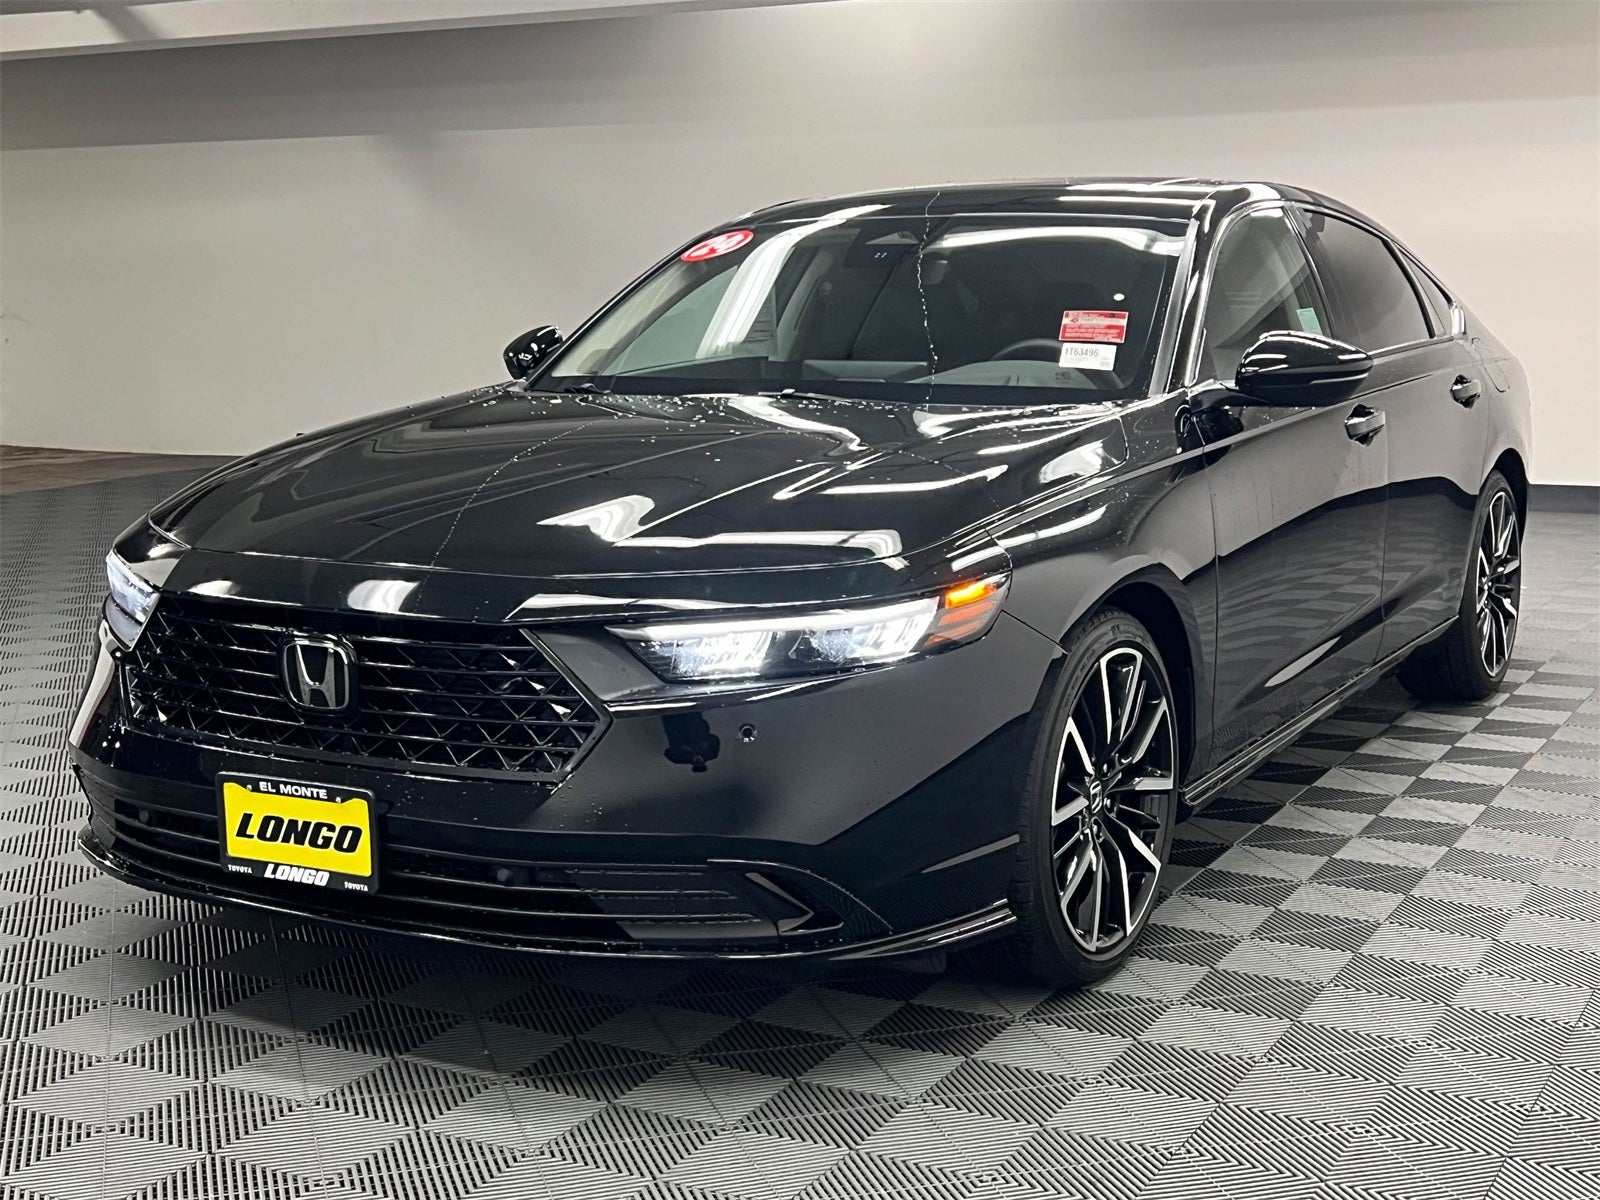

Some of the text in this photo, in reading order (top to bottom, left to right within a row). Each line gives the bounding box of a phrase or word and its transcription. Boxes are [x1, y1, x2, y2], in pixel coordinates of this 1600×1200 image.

[259, 781, 328, 799] EL MONTE
[236, 812, 363, 853] LONGO
[228, 864, 253, 874] TOYOTA
[264, 863, 330, 887] LONGO
[344, 881, 369, 892] TOYOTA
